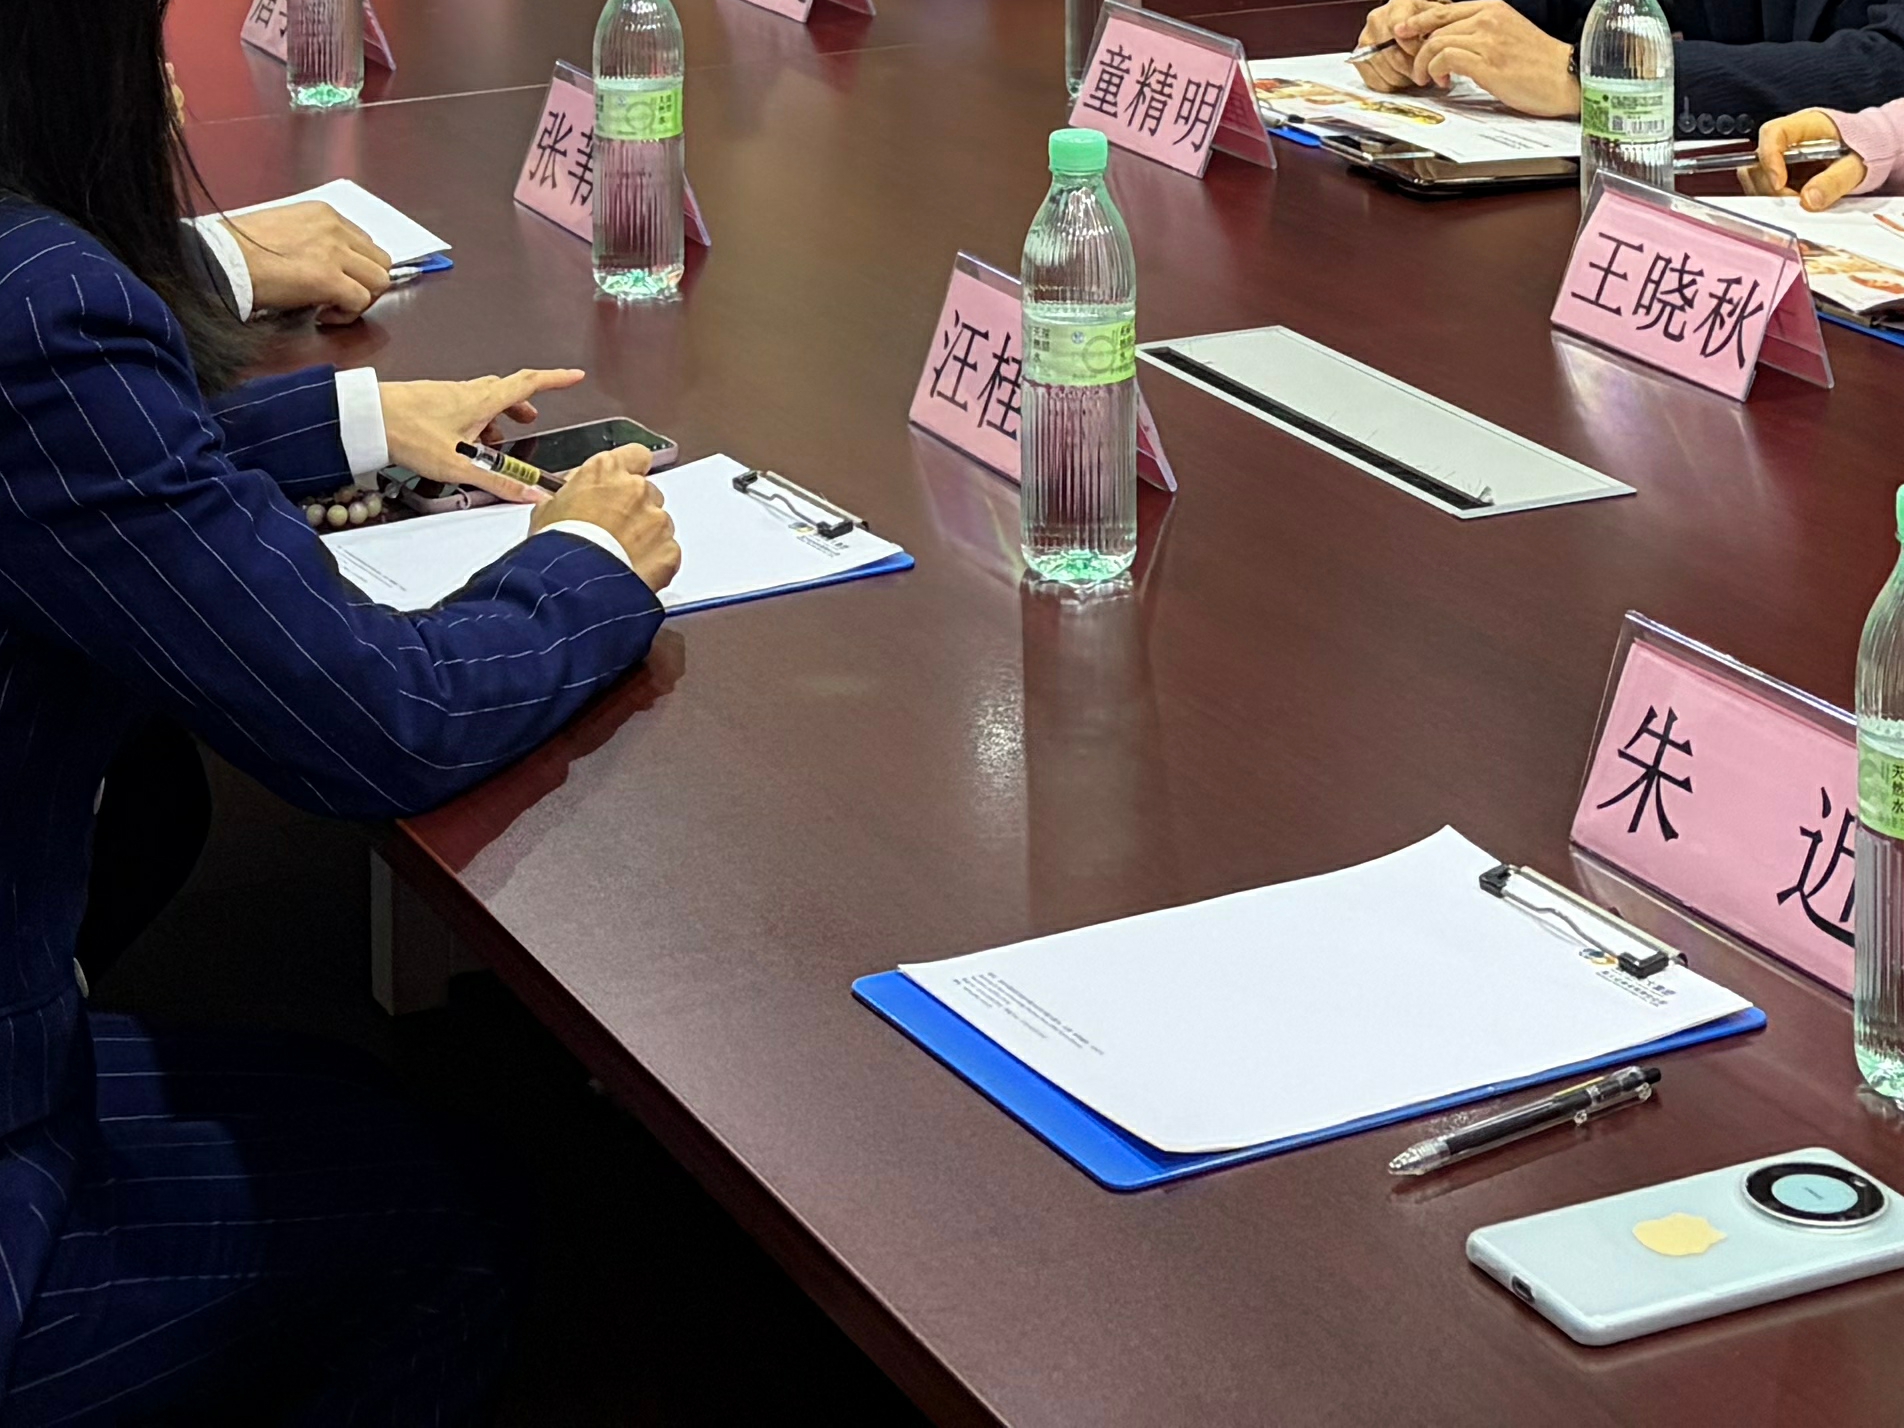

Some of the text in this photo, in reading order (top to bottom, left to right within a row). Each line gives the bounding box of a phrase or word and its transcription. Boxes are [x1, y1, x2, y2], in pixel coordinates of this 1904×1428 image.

[1083, 44, 1224, 153] 童精明
[1569, 231, 1764, 372] 王晓秋
